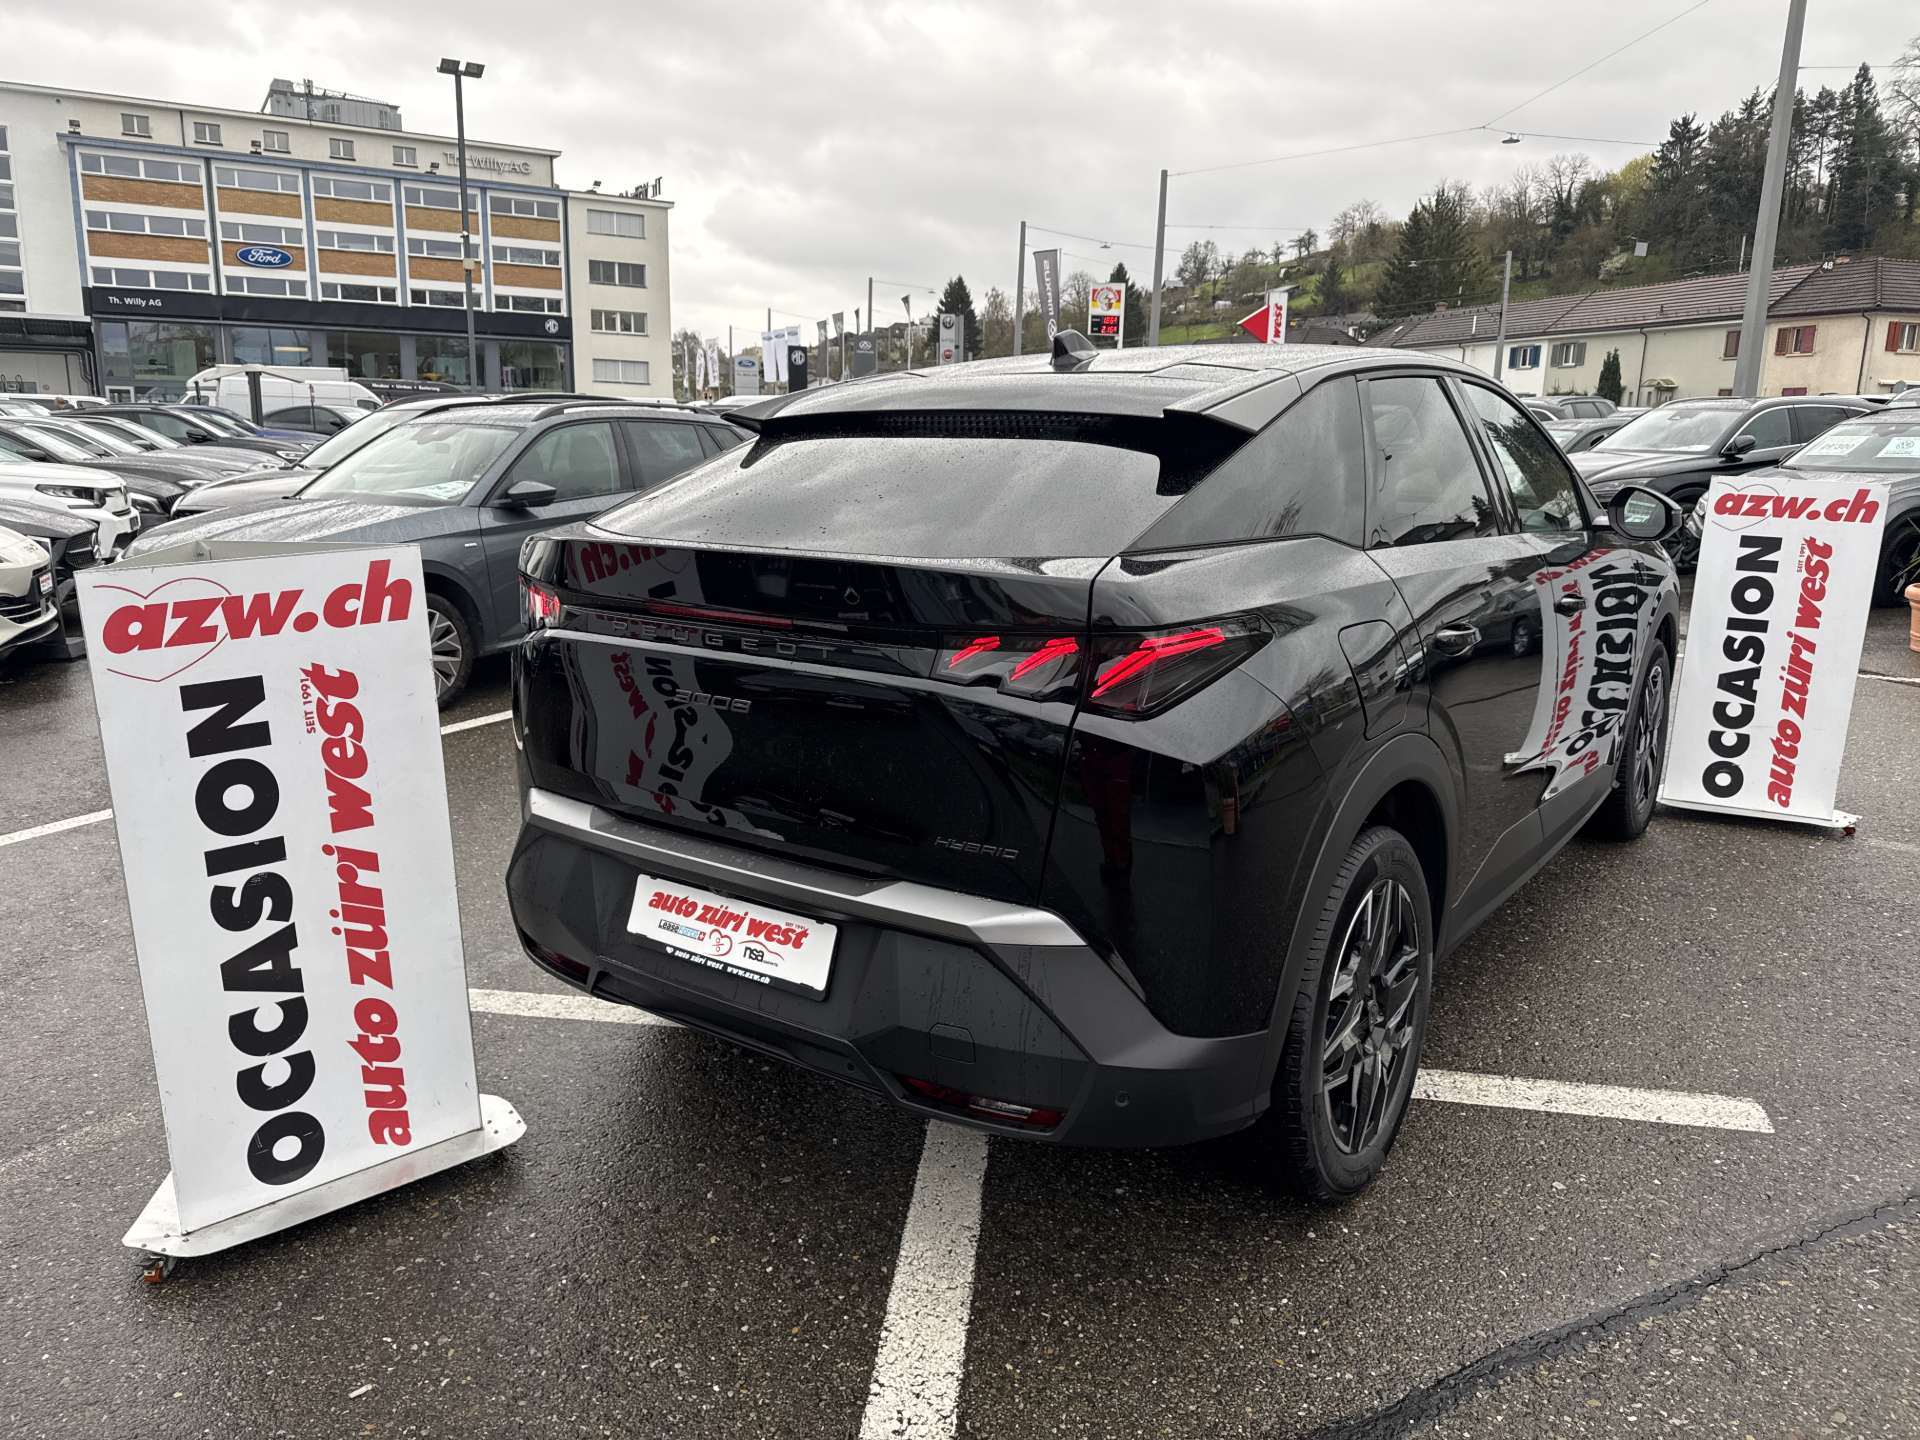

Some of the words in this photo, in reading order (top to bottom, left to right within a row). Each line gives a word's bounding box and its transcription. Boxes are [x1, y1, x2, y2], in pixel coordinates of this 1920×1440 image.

[471, 153, 505, 176] Willy
[510, 159, 532, 175] AG
[246, 247, 282, 265] Ford
[108, 296, 122, 304] Th.
[124, 297, 146, 307] Willy
[149, 298, 162, 306] AG
[1713, 487, 1881, 525] azw.ch
[102, 559, 413, 656] azw.ch
[1794, 536, 1834, 630] west
[612, 620, 837, 659] PEUGEOT
[1703, 535, 1783, 799] OCCASION
[1778, 631, 1818, 719] züri
[300, 678, 313, 706] 1991
[673, 688, 752, 714] 3008
[303, 710, 316, 734] SEIT
[300, 662, 375, 833] west
[1767, 719, 1802, 809] auto
[934, 836, 1020, 860] HYBRID
[179, 675, 326, 1186] OCCASION
[320, 843, 394, 989] züri
[648, 891, 699, 919] auto
[695, 903, 749, 933] züri
[746, 917, 810, 950] west
[743, 945, 765, 963] nsa
[347, 997, 413, 1147] auto
